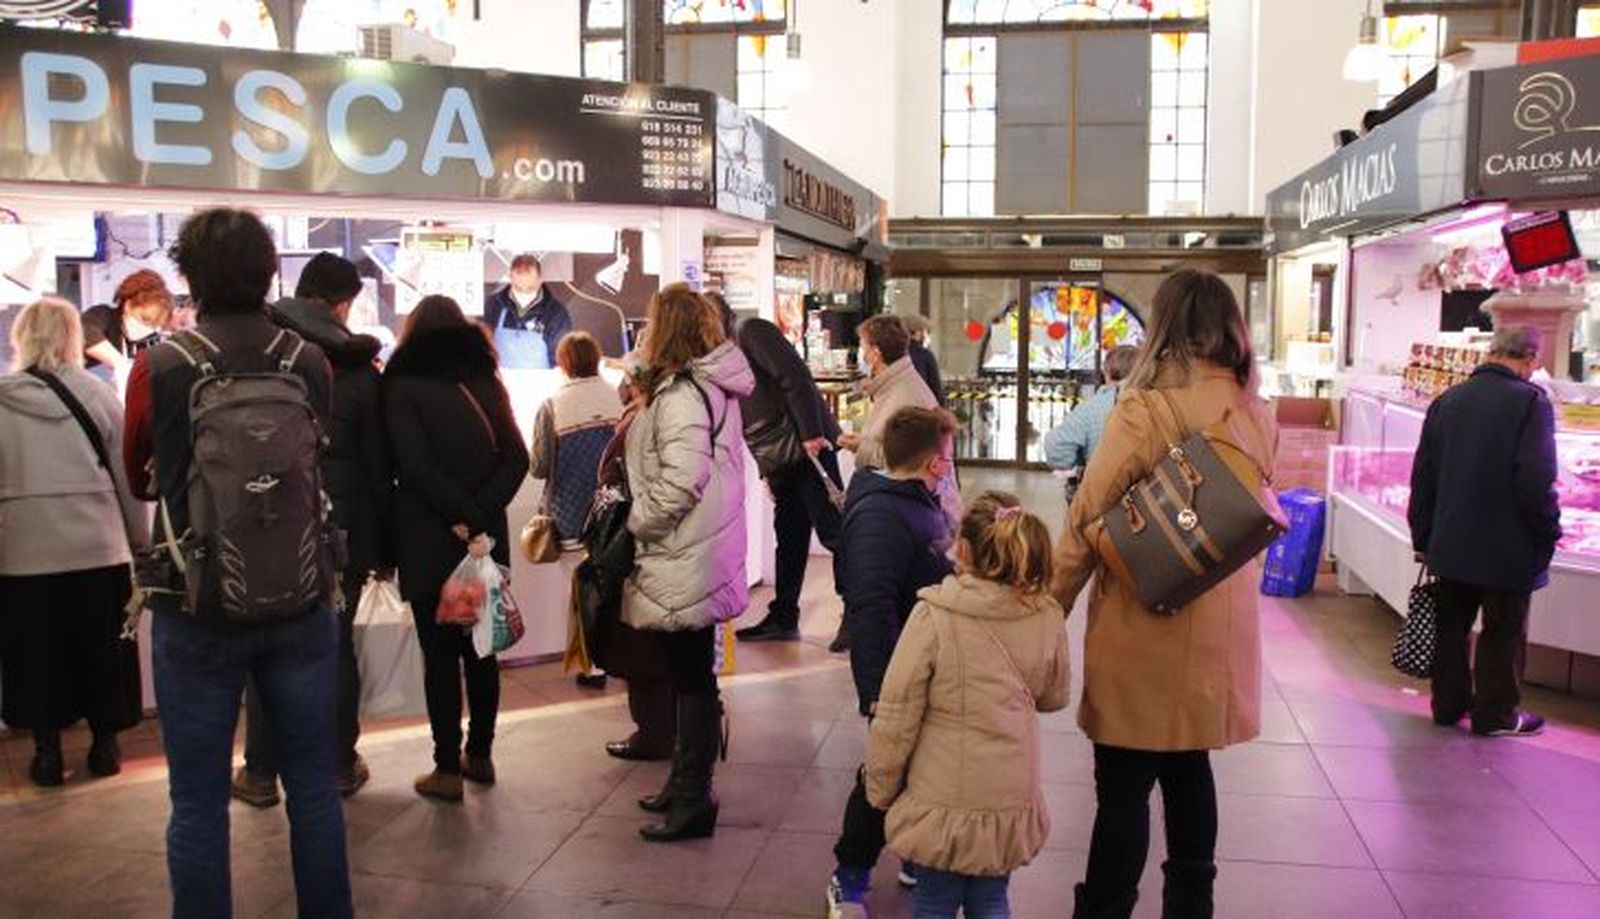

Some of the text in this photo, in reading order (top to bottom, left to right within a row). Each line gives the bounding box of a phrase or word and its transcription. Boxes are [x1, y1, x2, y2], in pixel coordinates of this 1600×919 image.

[21, 52, 586, 184] PESCA .com
[656, 100, 700, 114] CLIENTE
[1485, 151, 1565, 175] CARLOS
